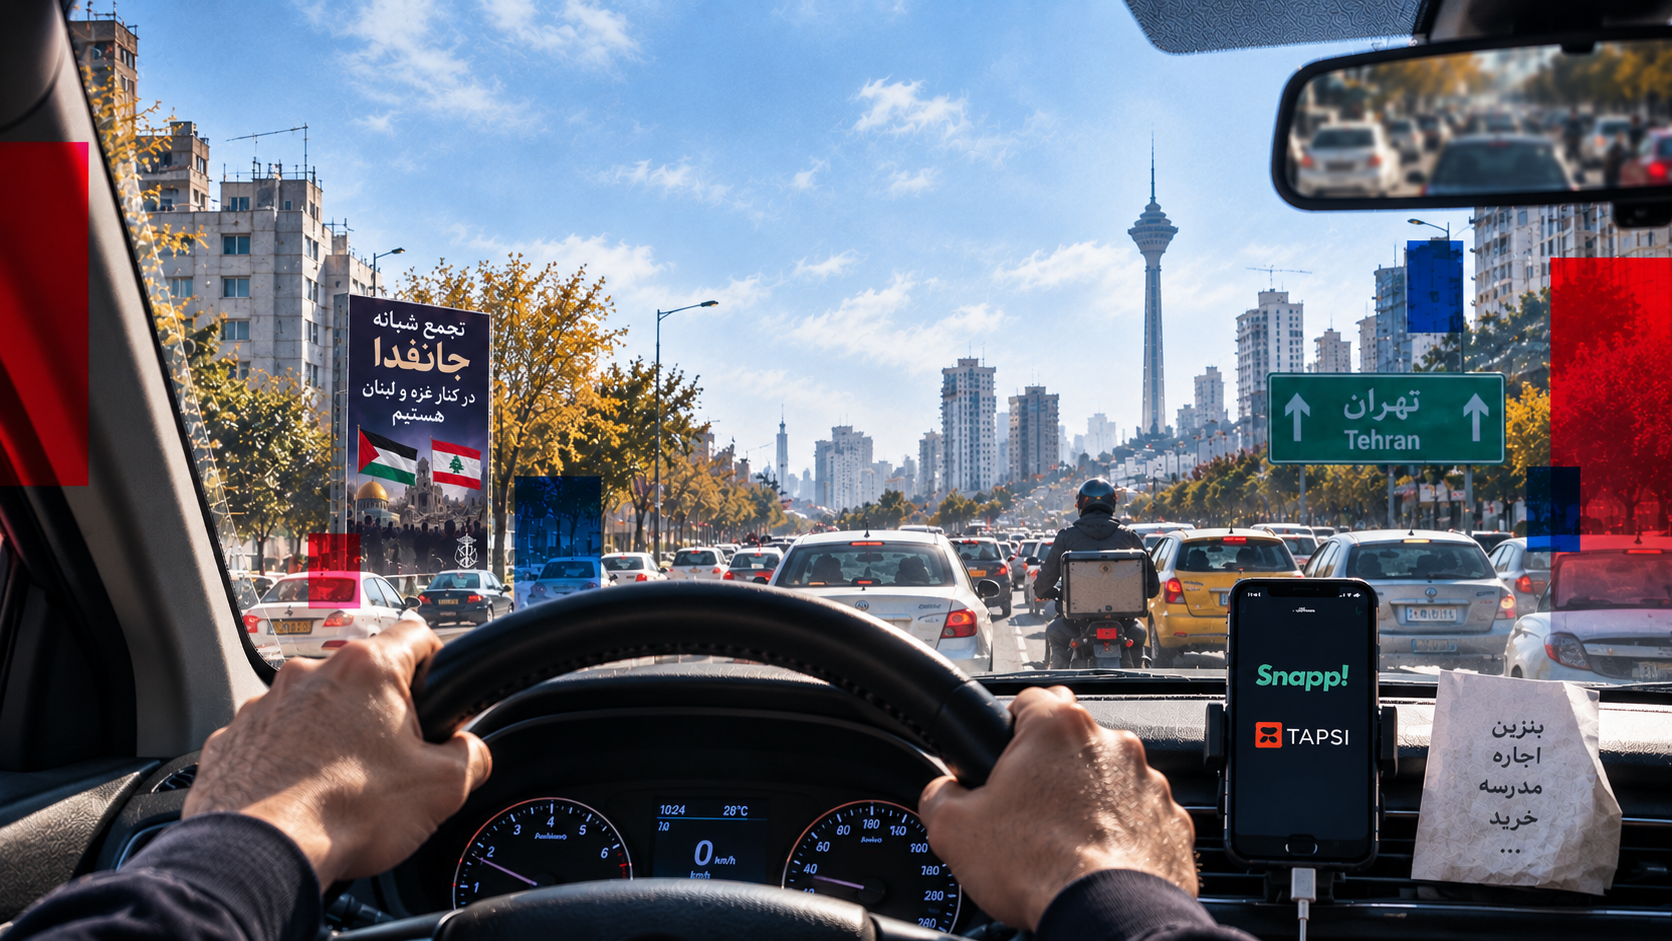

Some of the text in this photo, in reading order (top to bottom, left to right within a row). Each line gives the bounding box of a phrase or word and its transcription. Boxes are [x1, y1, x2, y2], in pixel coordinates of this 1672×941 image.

[373, 310, 466, 339] تجمع شبانه
[373, 336, 471, 382] جانفدا
[362, 379, 476, 407] در کنار غزه و لبنان
[1343, 387, 1421, 422] تهران
[392, 407, 445, 426] هستیم
[1343, 429, 1421, 450] Tehran
[1255, 663, 1350, 692] Snapp!
[1286, 728, 1349, 746] TAPSI
[1491, 720, 1545, 739] بنزین
[1492, 746, 1541, 768] اجاره
[1479, 779, 1543, 799] مدرسه
[722, 805, 749, 817] 28°C
[1489, 809, 1538, 831] خرید
[513, 824, 522, 836] 3
[546, 816, 555, 828] 4
[578, 824, 587, 836] 5
[486, 846, 496, 858] 2
[600, 847, 609, 859] 6
[694, 839, 714, 866] 0
[815, 841, 830, 853] 60
[803, 863, 818, 875] 40
[473, 881, 480, 893] 1
